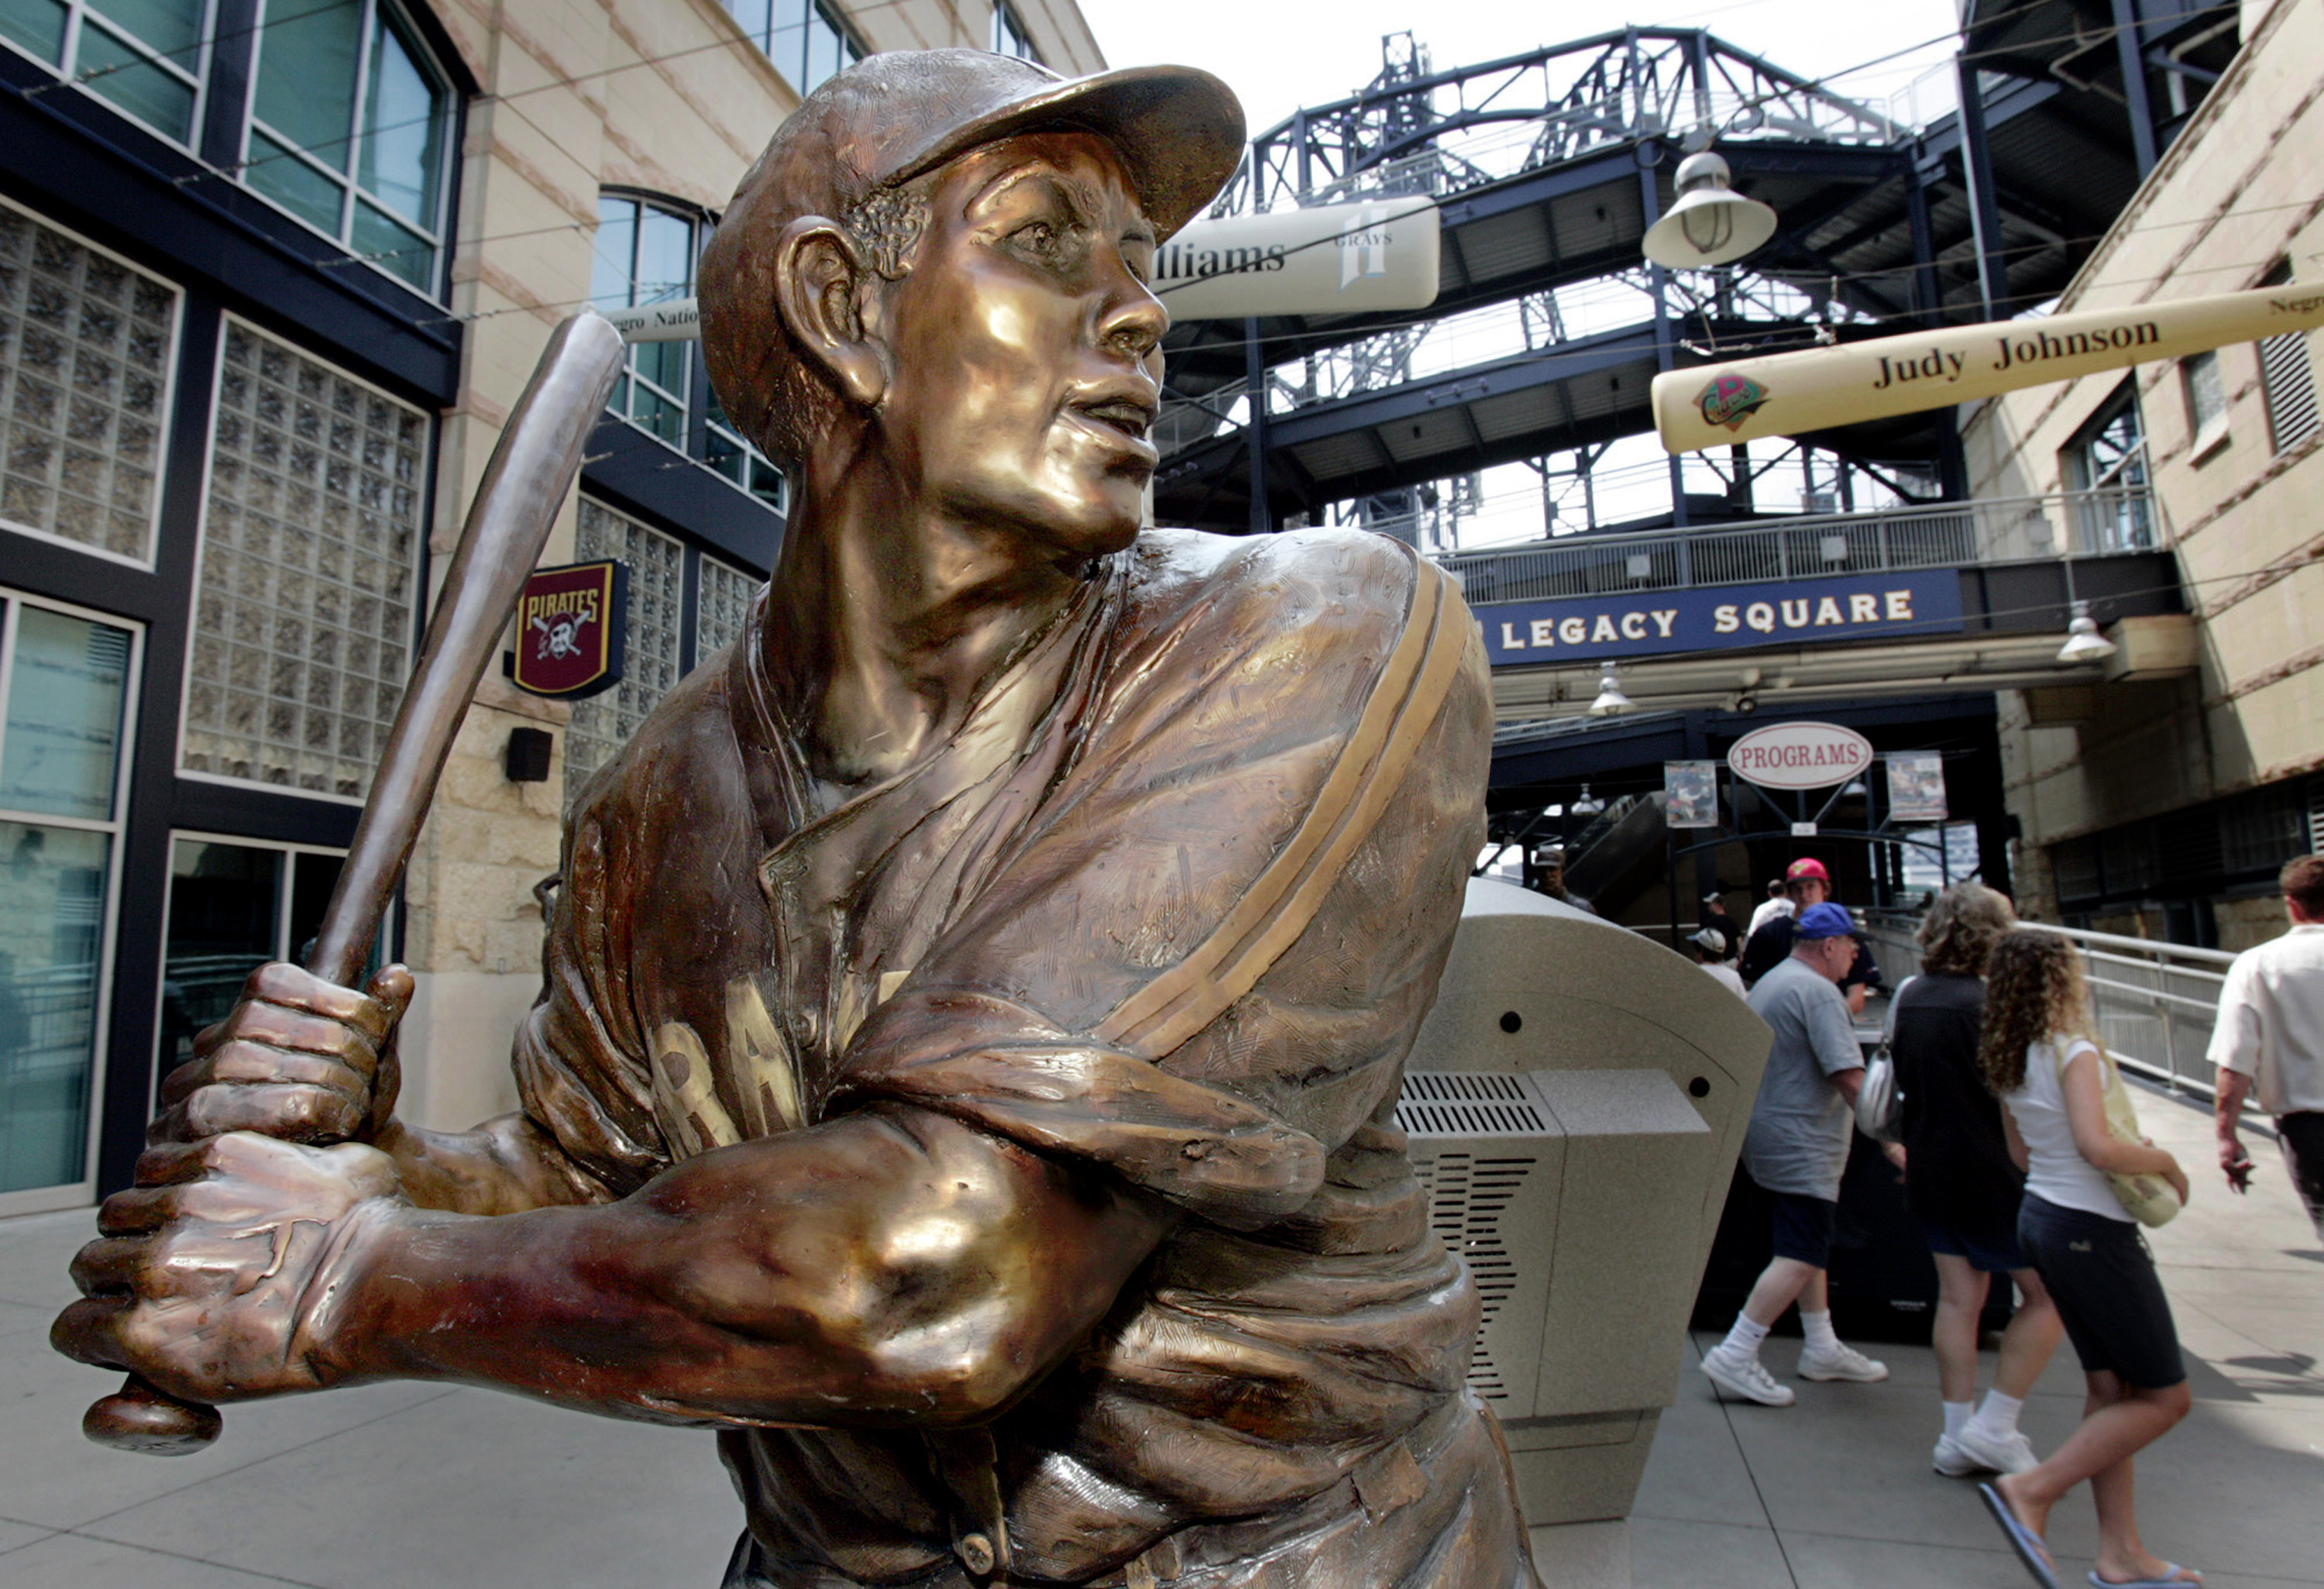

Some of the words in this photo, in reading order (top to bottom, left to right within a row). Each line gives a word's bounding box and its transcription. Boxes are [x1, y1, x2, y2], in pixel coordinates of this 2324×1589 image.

[1334, 233, 1392, 246] GRAYS
[2269, 296, 2324, 316] Negr
[1873, 347, 1966, 389] Judy
[1992, 320, 2161, 370] Johnson
[526, 588, 599, 631] PIRATES
[1501, 609, 1678, 650] LEGACY
[1714, 590, 1913, 634] SQUARE
[1740, 743, 1859, 769] PROGRAMS
